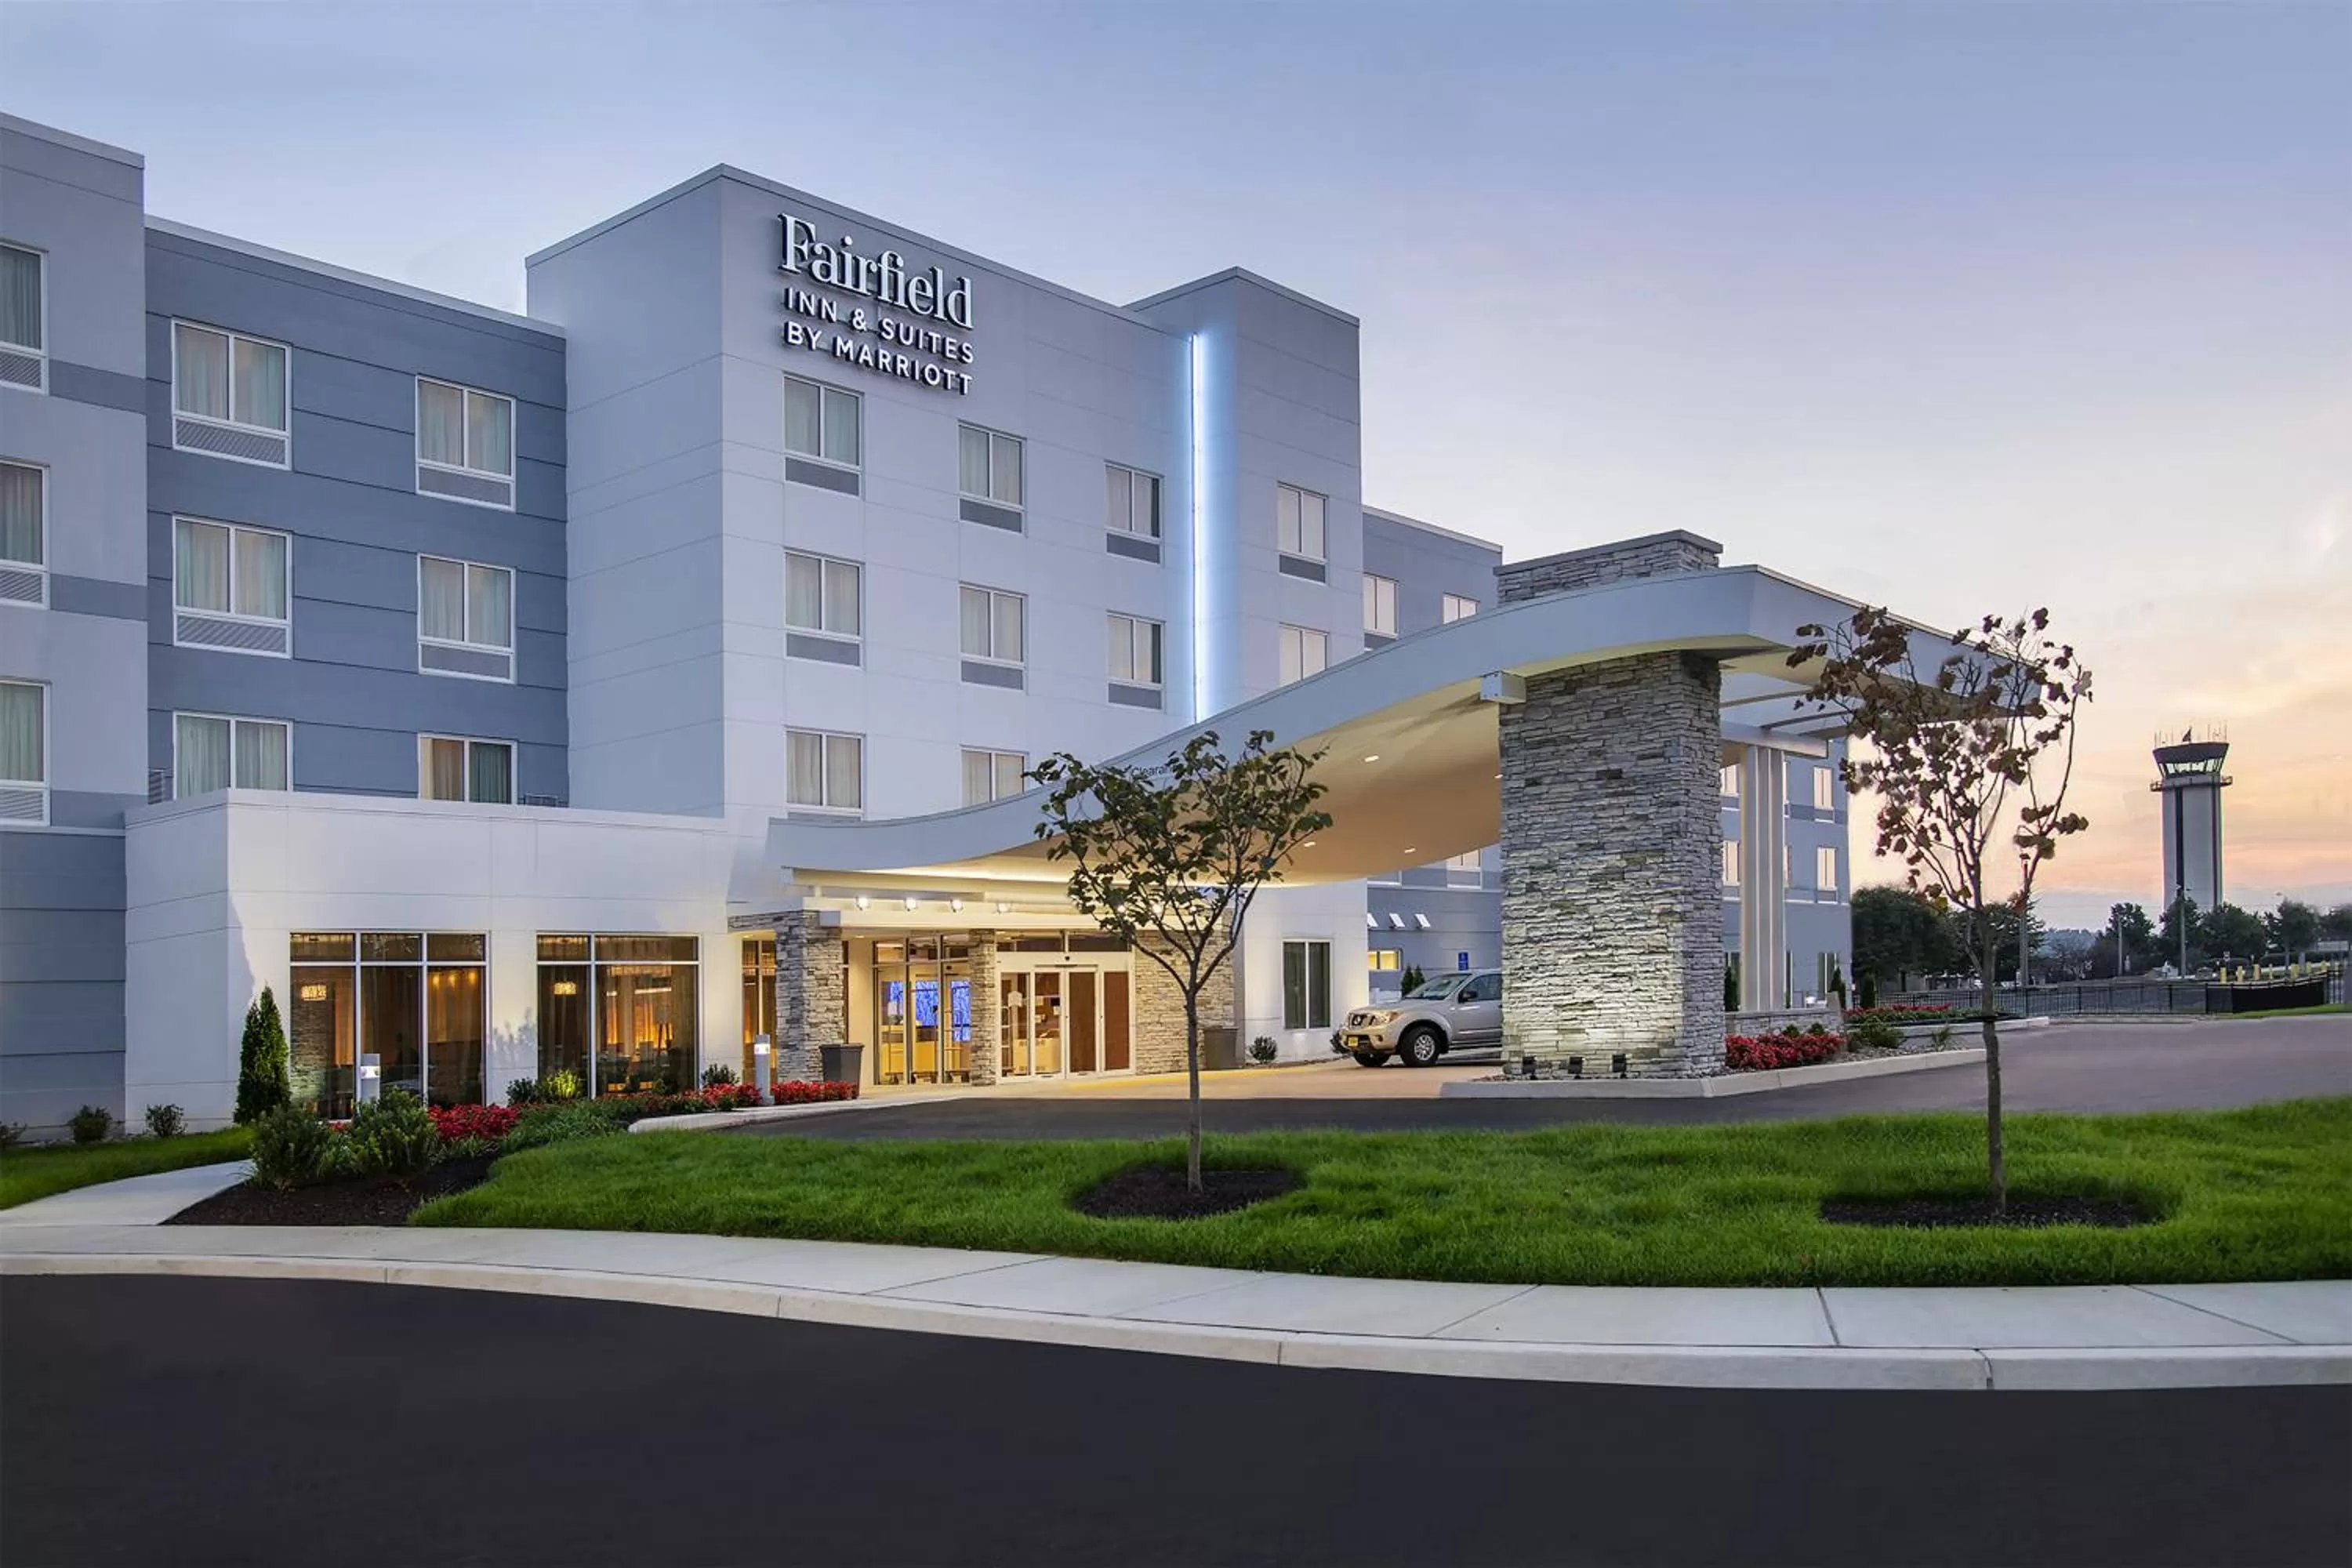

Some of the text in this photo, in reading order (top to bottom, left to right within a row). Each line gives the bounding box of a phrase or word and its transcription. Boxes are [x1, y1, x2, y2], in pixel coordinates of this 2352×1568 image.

[777, 212, 975, 330] Fairfield
[785, 287, 974, 364] INN & SUITES
[786, 321, 973, 395] BY MARRIOTT
